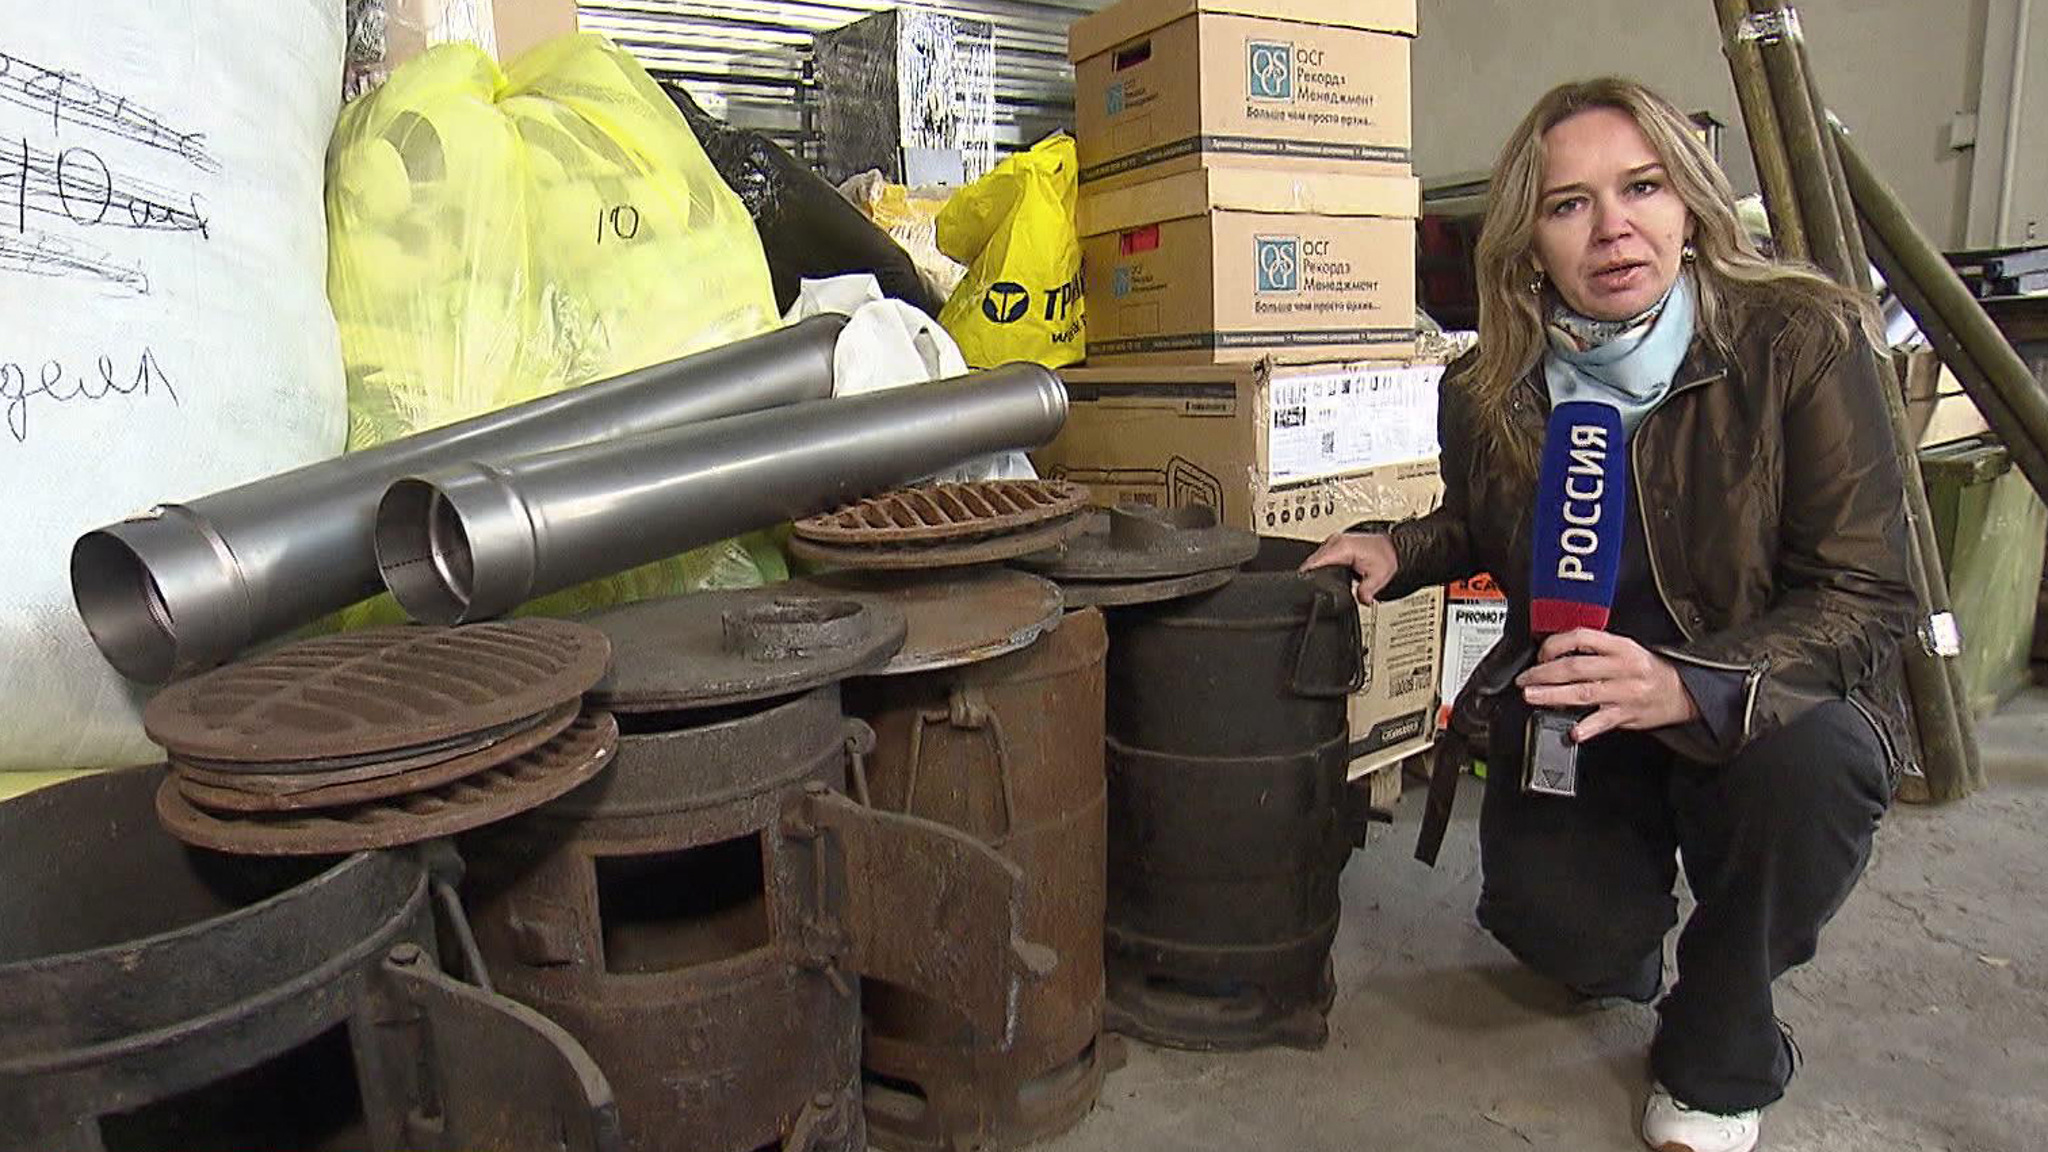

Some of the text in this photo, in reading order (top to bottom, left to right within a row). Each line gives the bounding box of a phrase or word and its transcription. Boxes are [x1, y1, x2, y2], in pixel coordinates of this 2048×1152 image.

[1296, 49, 1325, 66] ОСГ
[597, 206, 639, 246] 10
[1302, 240, 1330, 256] ОСГ
[1303, 276, 1379, 294] Менеджмент
[1557, 424, 1608, 582] РОССИЯ
[1456, 610, 1497, 624] PROMO
